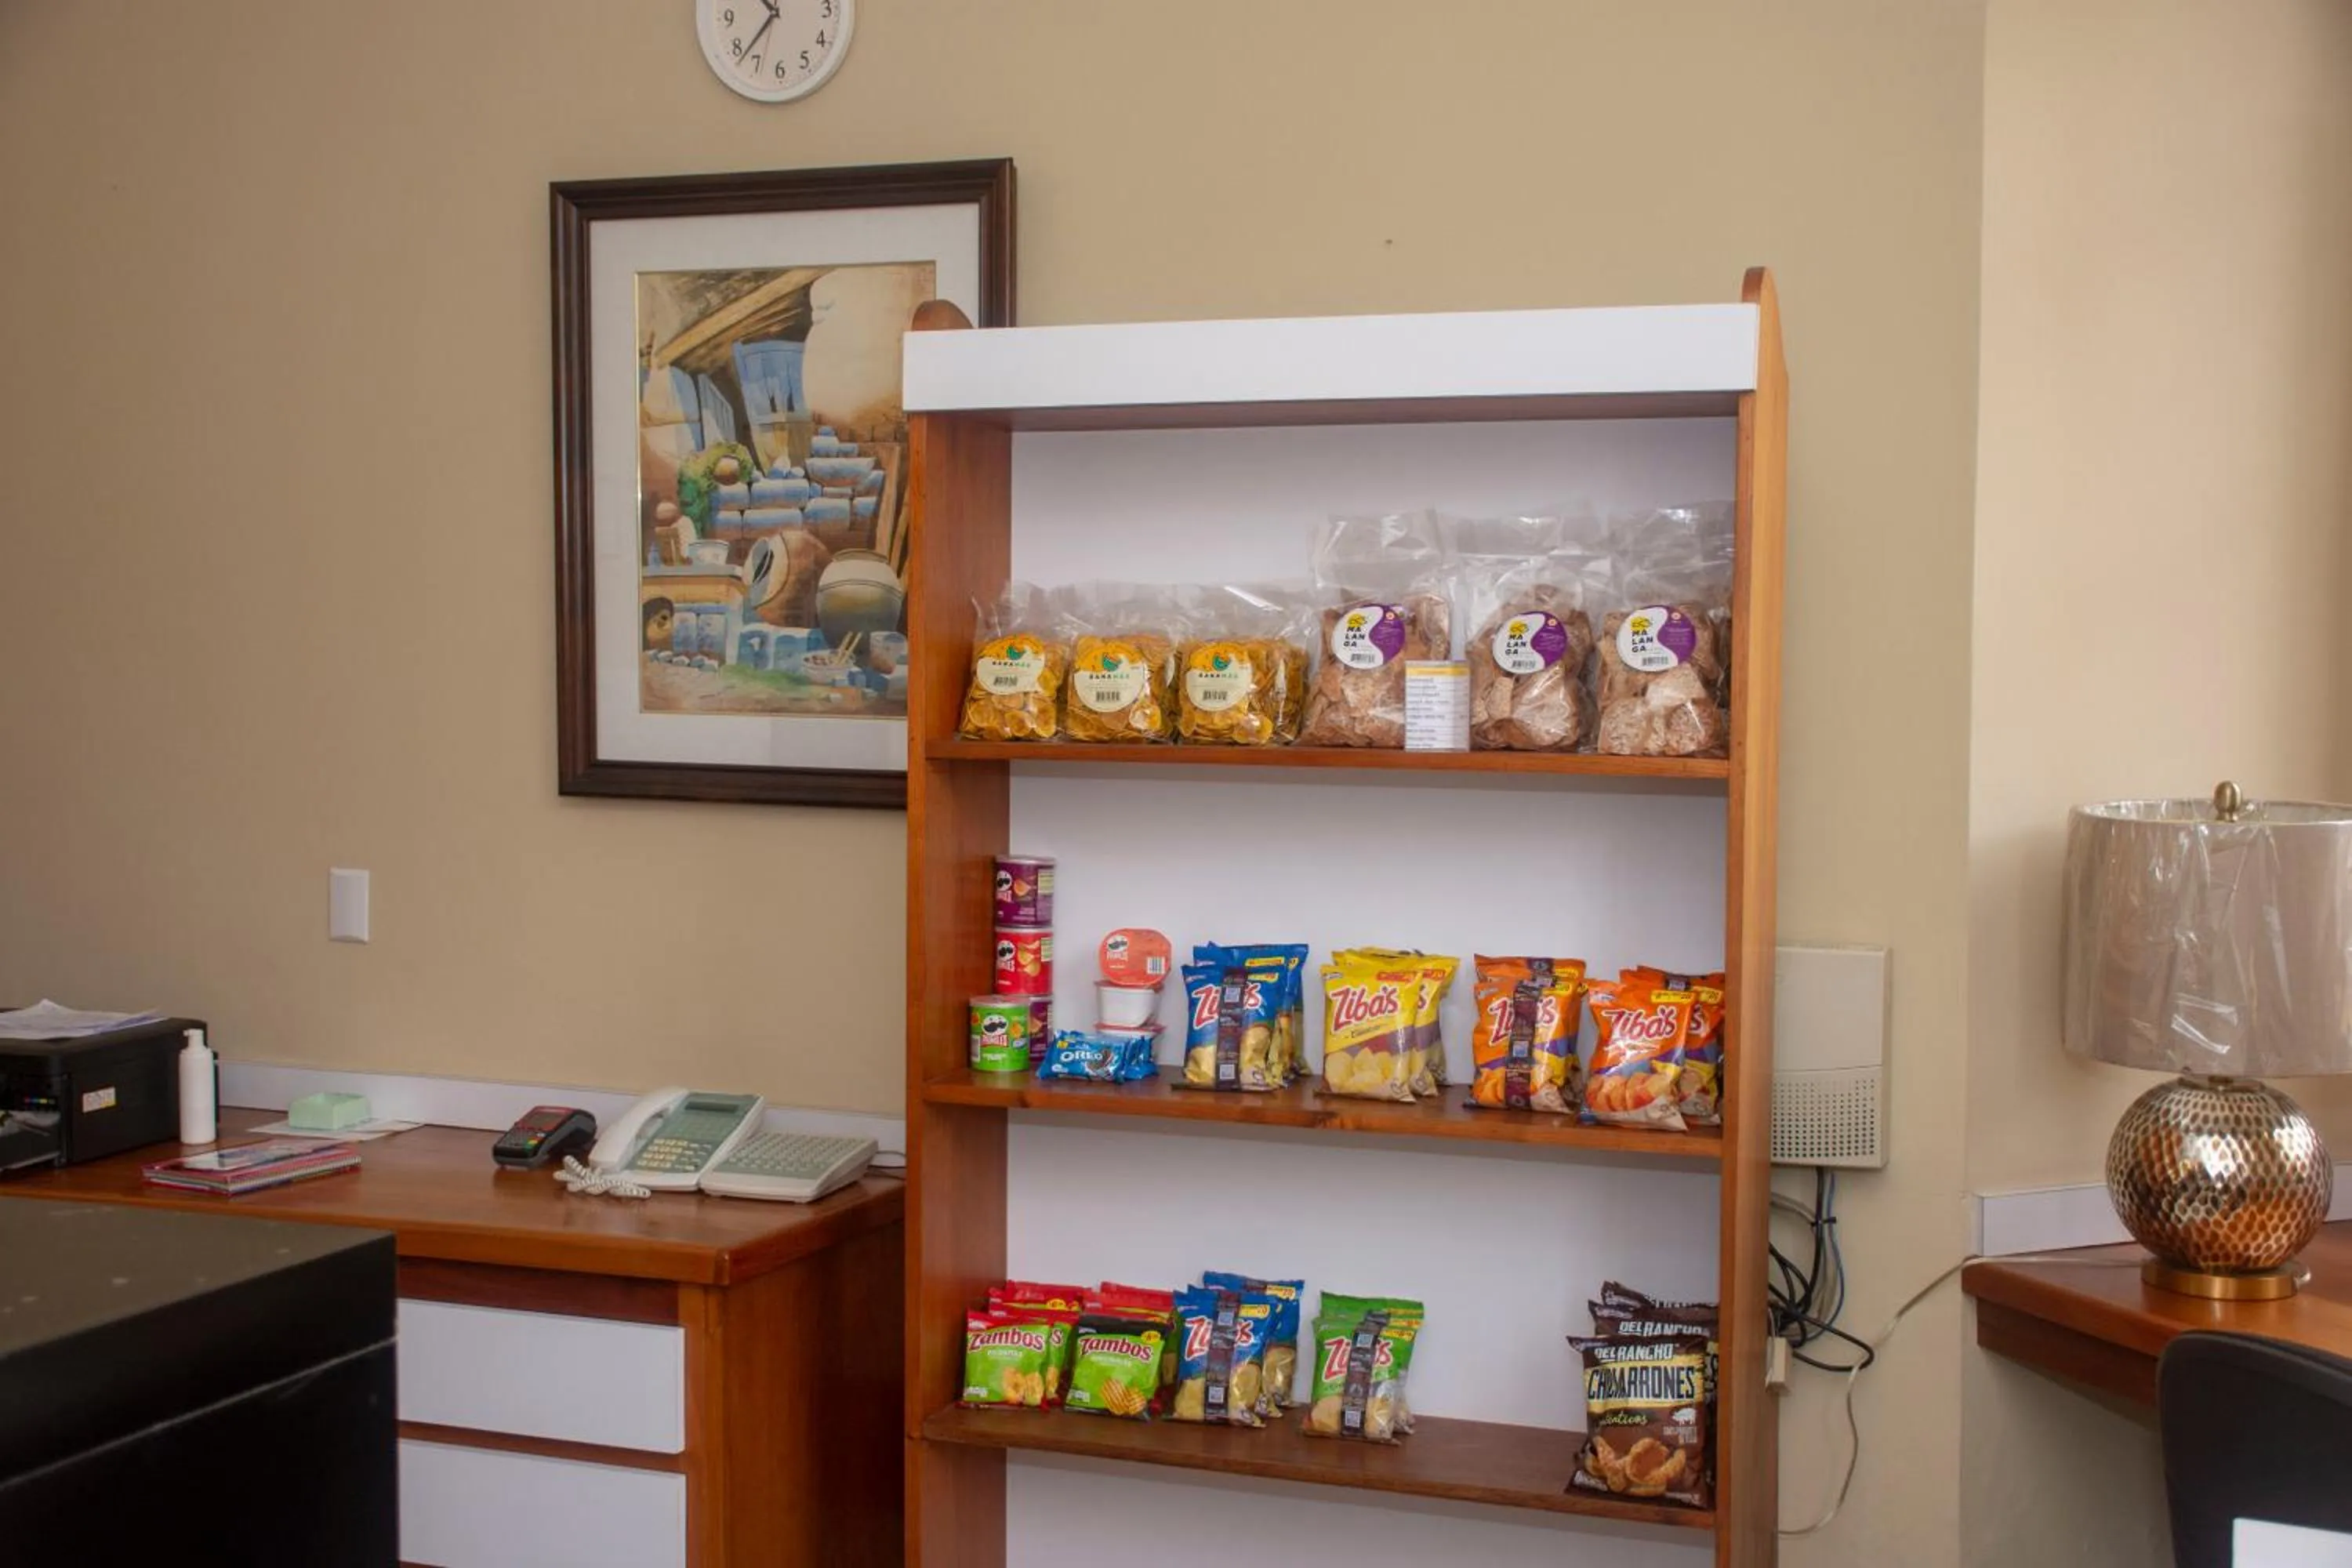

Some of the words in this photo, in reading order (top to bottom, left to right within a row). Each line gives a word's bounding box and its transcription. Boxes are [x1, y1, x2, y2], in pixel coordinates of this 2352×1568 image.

[821, 0, 832, 17] 3
[724, 9, 735, 27] 9
[732, 38, 742, 56] 8
[815, 30, 826, 47] 4
[751, 55, 760, 73] 7
[775, 60, 785, 78] 6
[800, 51, 809, 69] 5
[1330, 985, 1399, 1033] Ziba's
[1619, 1321, 1643, 1332] DEL
[967, 1327, 1044, 1352] Zambos
[1079, 1337, 1152, 1363] Zambos
[1617, 1343, 1674, 1362] RANCHO
